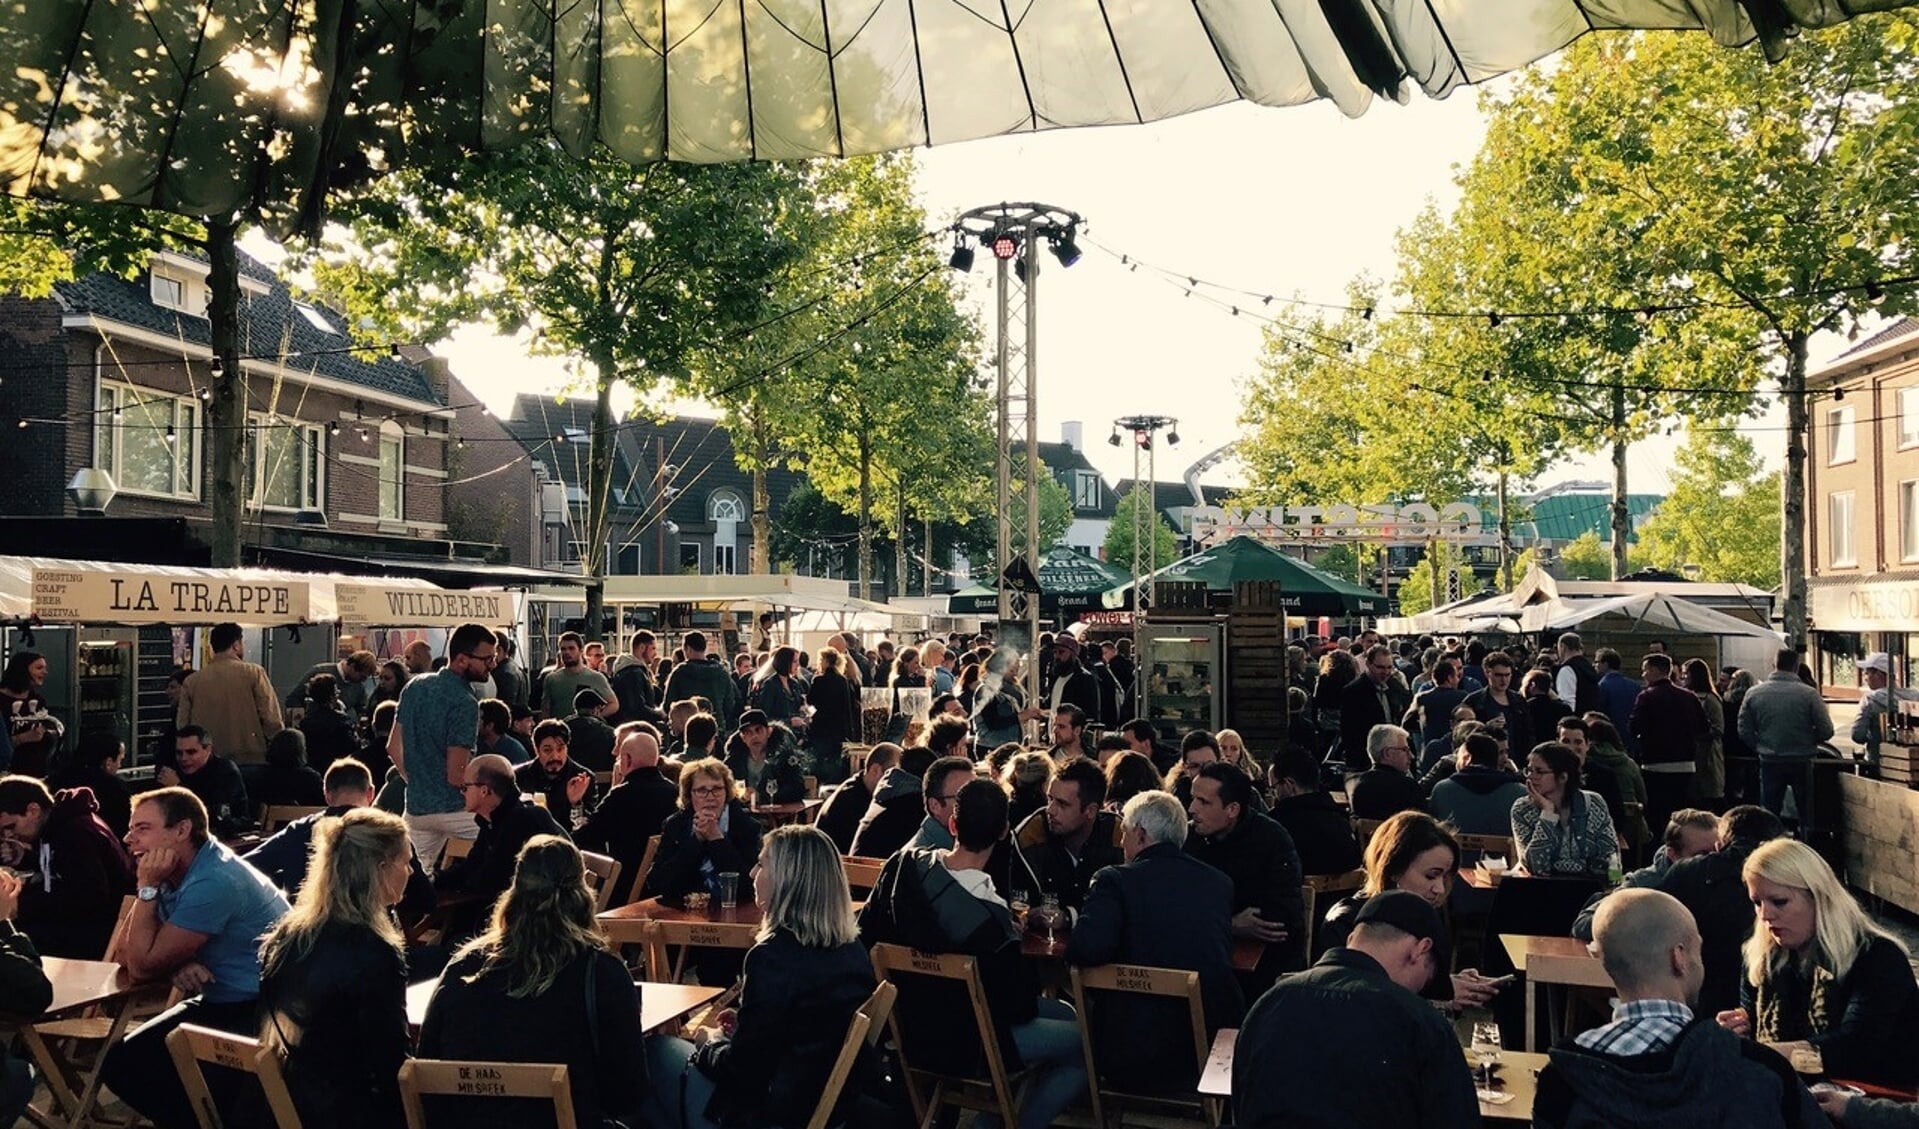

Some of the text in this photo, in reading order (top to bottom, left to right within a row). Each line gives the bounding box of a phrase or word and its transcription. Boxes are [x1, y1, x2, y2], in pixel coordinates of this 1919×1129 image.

[35, 572, 83, 582] GOESTING
[35, 584, 67, 593] CRAFT
[35, 597, 62, 605] BEER
[110, 579, 289, 614] LA TRAPPE
[385, 591, 499, 618] WILDEREN
[1058, 597, 1088, 606] Brand
[1280, 597, 1301, 606] and
[459, 1067, 502, 1080] DE HAAS
